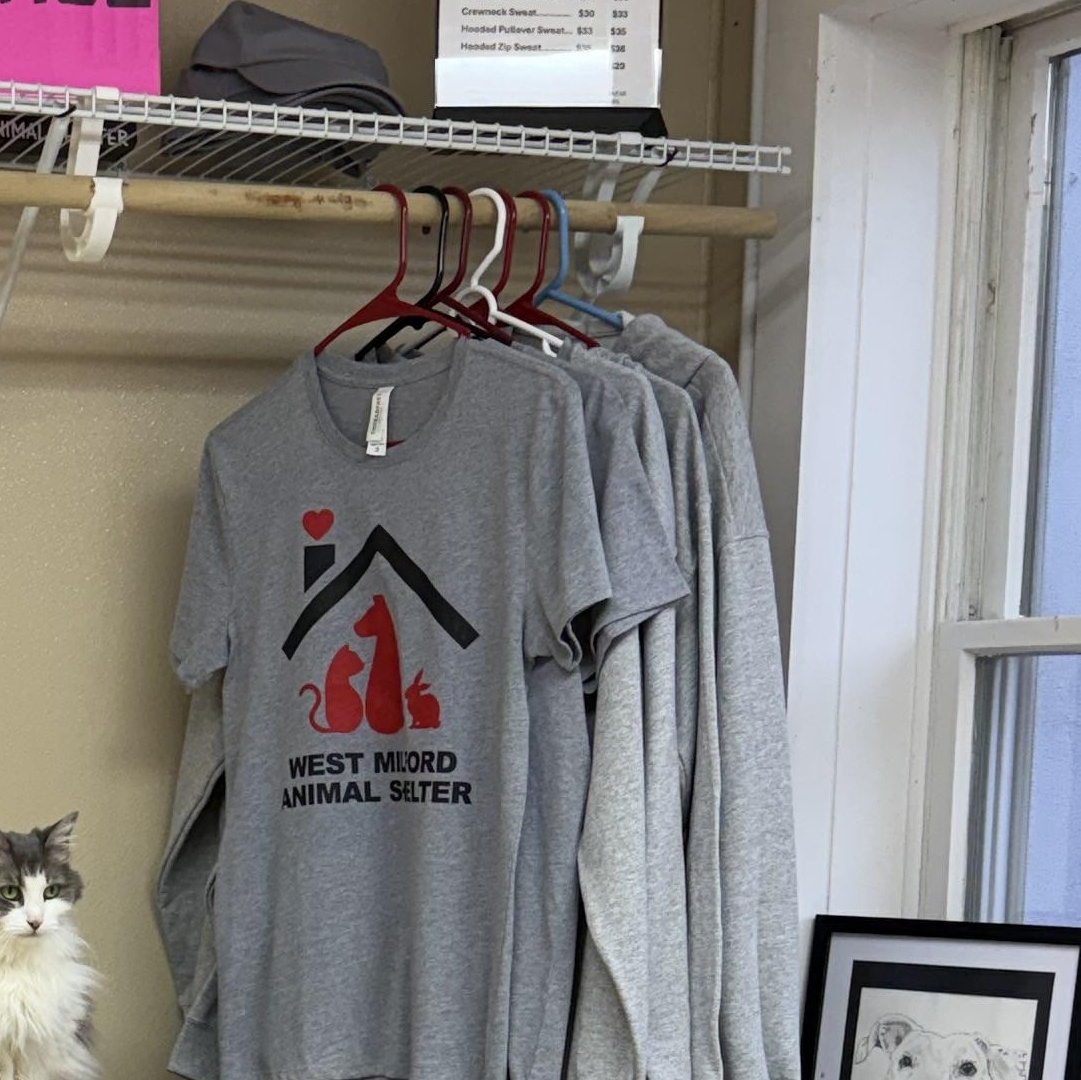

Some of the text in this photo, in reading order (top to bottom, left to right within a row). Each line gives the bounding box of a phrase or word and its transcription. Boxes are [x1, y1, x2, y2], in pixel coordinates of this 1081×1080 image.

[461, 7, 507, 16] Crewneck
[578, 9, 595, 17] $30
[461, 25, 497, 33] Hooded
[499, 25, 535, 34] Pullover
[461, 42, 496, 51] Hooded
[498, 43, 512, 52] Zip
[288, 752, 364, 780] WEST
[281, 780, 382, 810] ANIMAL
